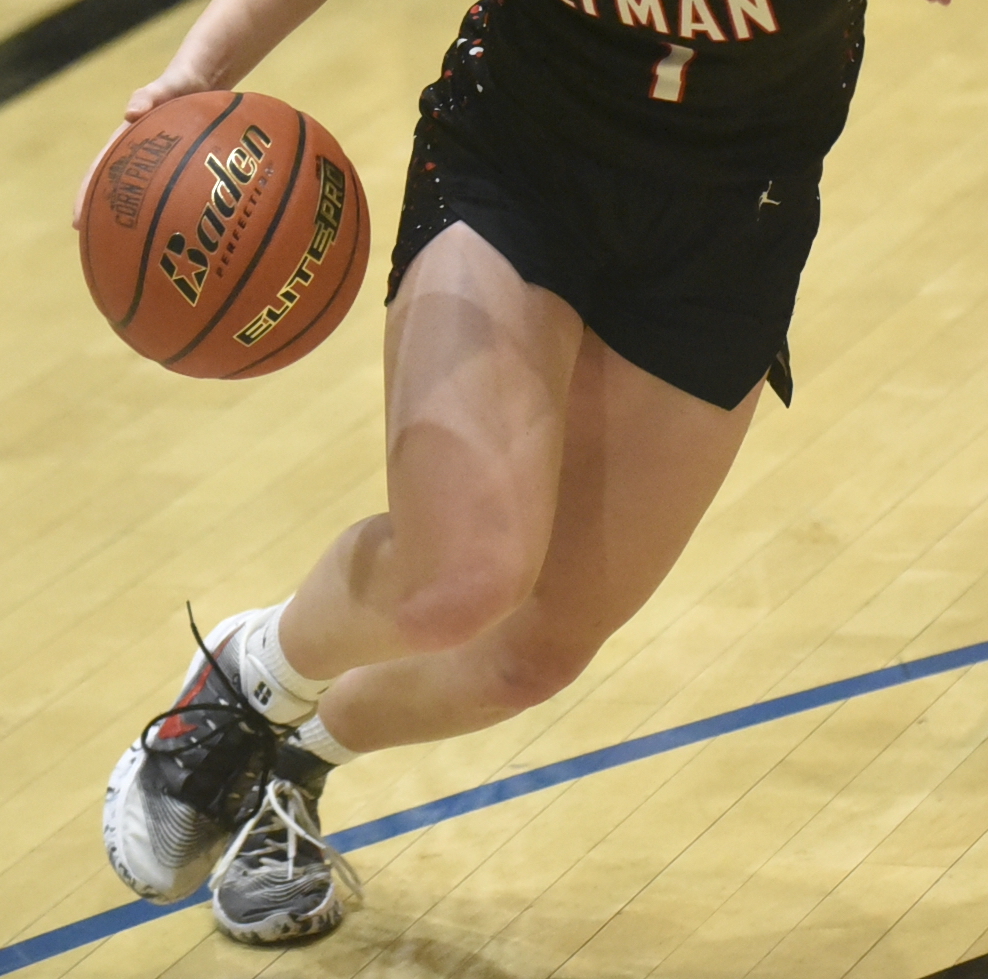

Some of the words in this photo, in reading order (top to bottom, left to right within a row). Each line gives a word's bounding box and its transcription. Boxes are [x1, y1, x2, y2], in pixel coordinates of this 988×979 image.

[648, 42, 697, 103] 1
[123, 130, 180, 181] PALACE
[115, 181, 145, 229] CORN
[158, 123, 273, 307] Baden
[233, 219, 335, 347] ELITE
